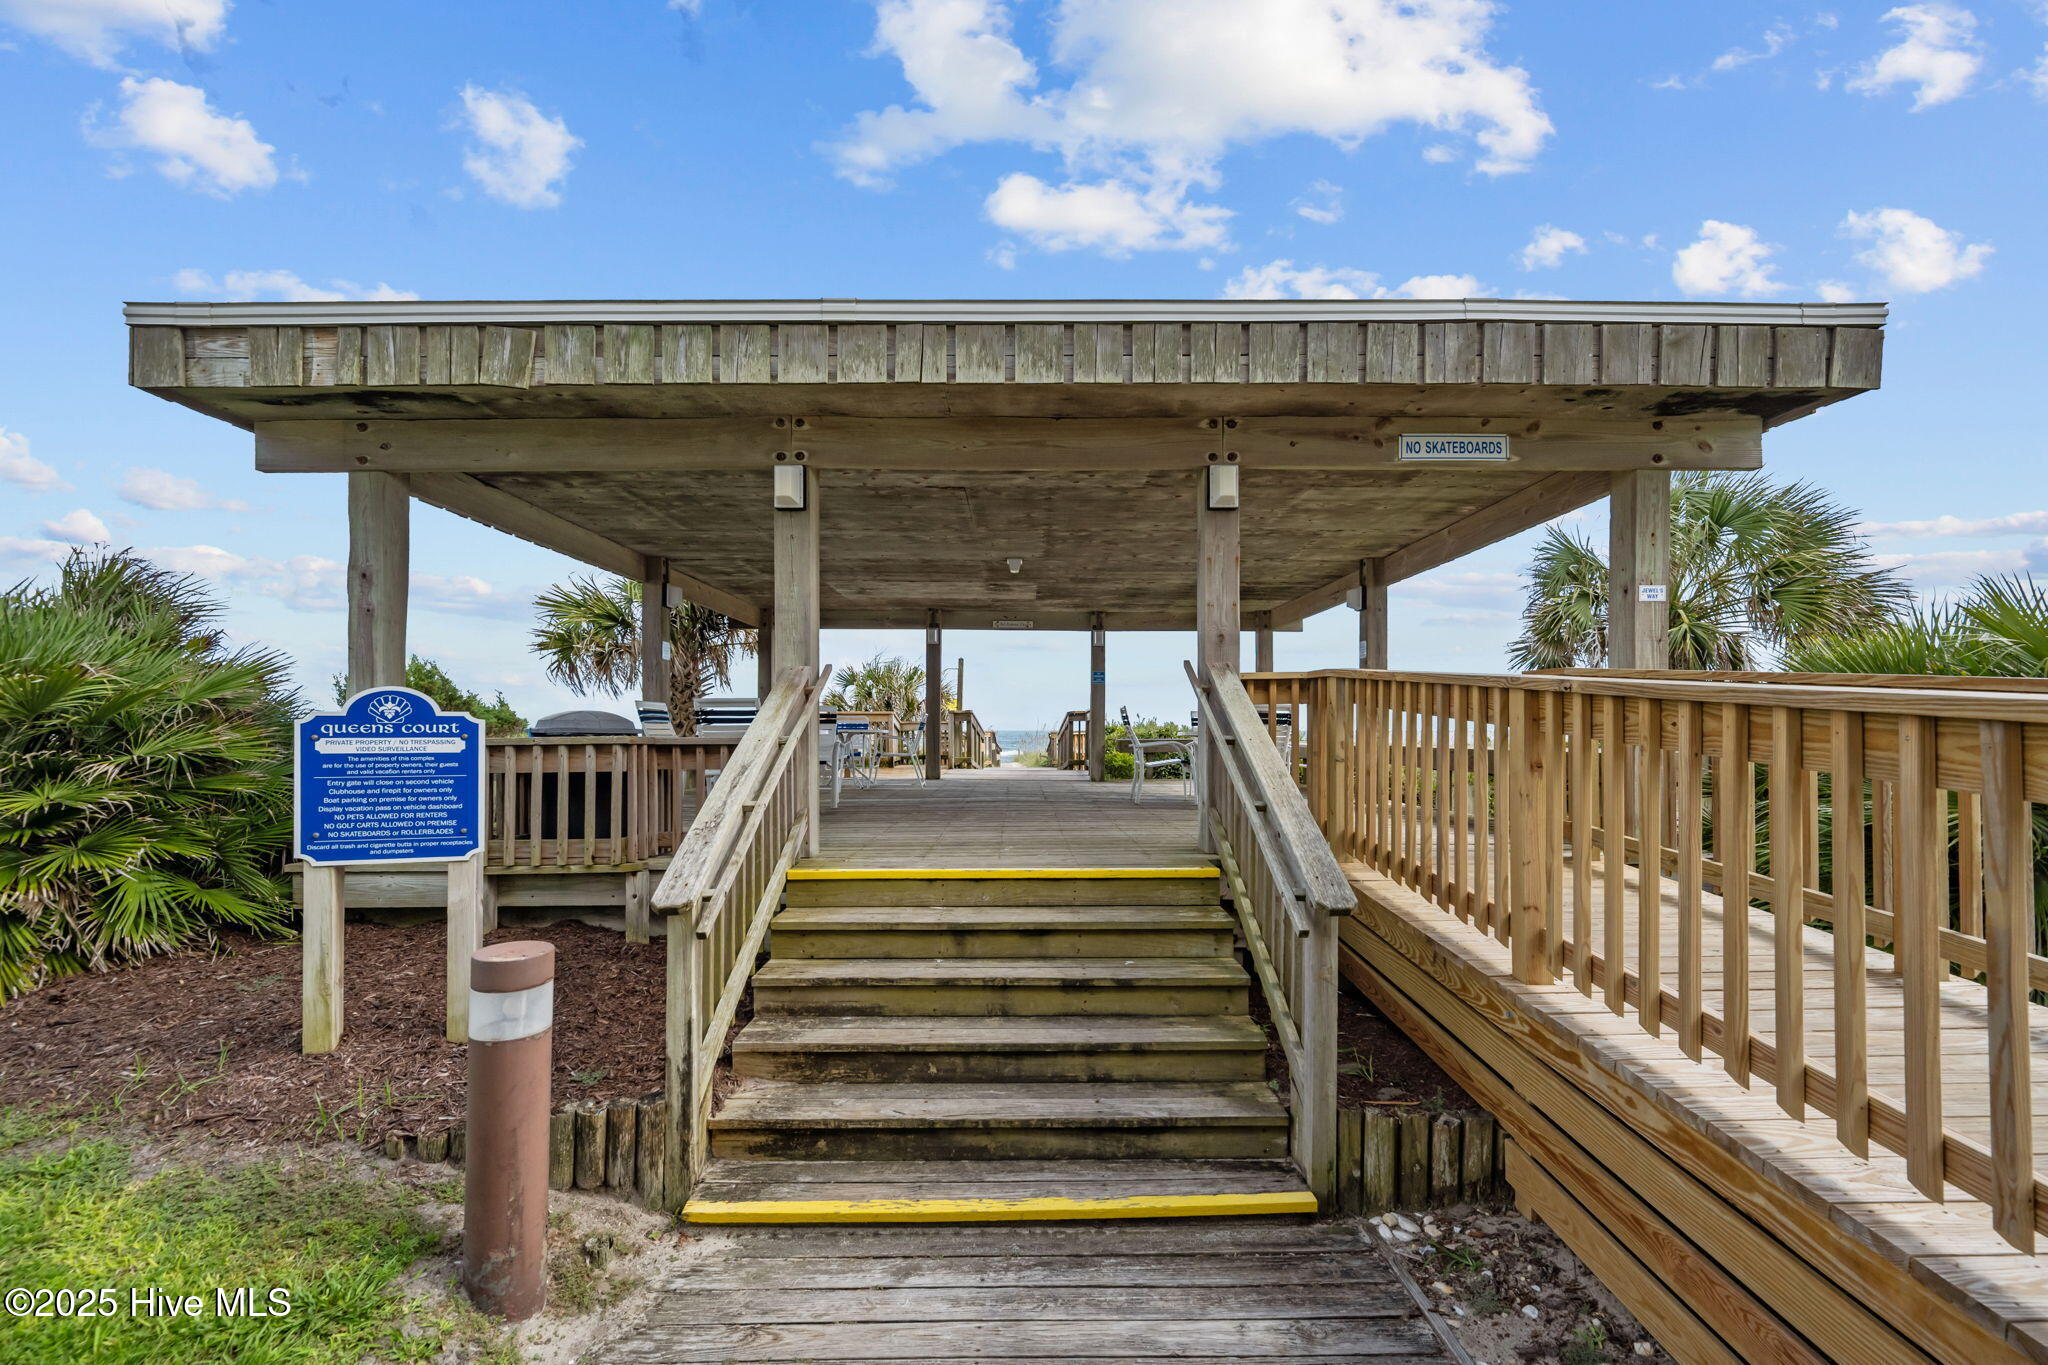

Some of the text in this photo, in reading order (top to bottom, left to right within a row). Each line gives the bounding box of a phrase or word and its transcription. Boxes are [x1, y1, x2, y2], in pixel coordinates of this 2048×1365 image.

[1406, 441, 1502, 454] NO SKATEBOARDS
[321, 723, 460, 736] queens court
